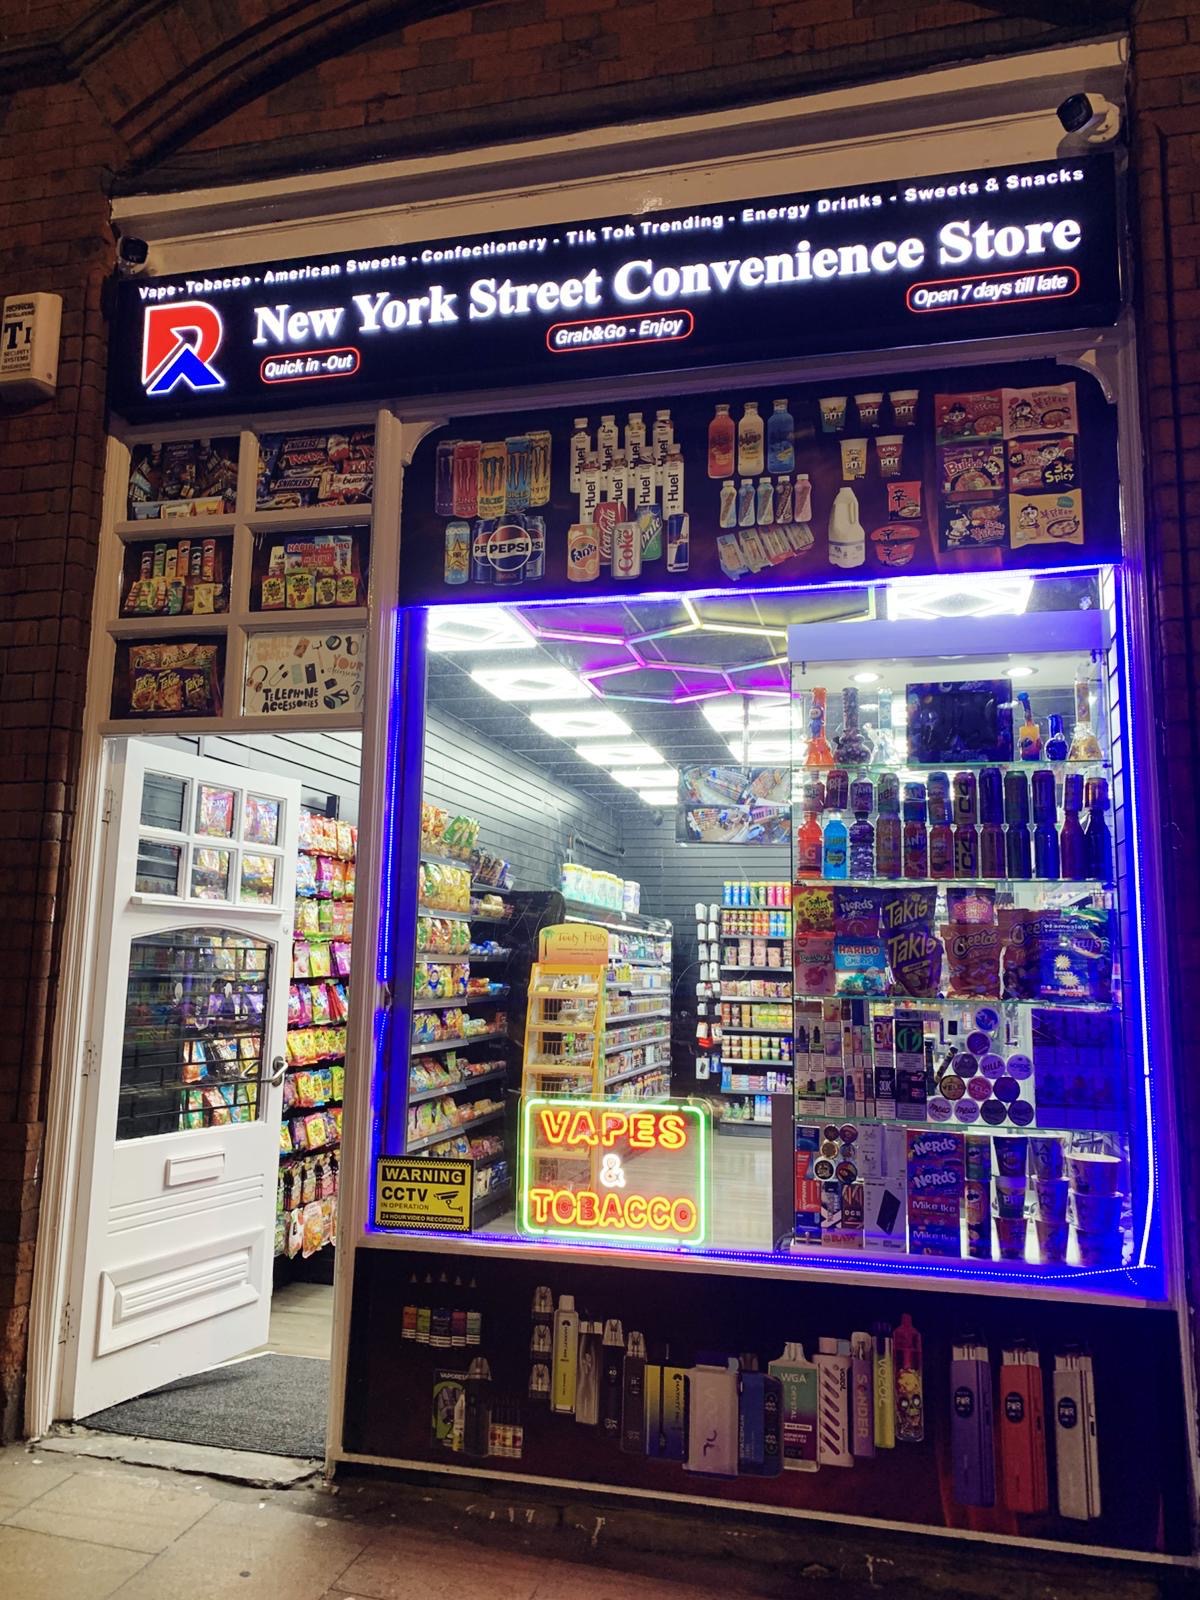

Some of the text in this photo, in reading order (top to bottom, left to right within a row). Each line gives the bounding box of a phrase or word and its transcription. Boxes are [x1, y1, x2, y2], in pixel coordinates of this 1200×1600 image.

[139, 284, 176, 300] Vape
[186, 275, 250, 294] Tobacco
[264, 263, 340, 284] American
[346, 254, 406, 274] Sweets
[421, 236, 547, 264] Confectionery
[566, 229, 597, 245] Tik
[601, 224, 635, 241] Tok
[641, 214, 724, 235] Trending
[742, 204, 810, 223] Energy
[817, 193, 882, 213] Drinks
[904, 181, 979, 202] Sweets
[984, 177, 999, 191] &
[1006, 168, 1084, 190] Snacks
[252, 217, 1082, 345] New York Street Convenience Store
[914, 273, 1068, 307] Open 7 days till late
[639, 317, 684, 337] Enjoy
[264, 358, 304, 378] Quick
[305, 357, 319, 373] in
[639, 474, 651, 504] Huel
[667, 472, 679, 502] Huel
[1044, 471, 1075, 484] Spicy
[584, 480, 596, 509] Huel
[489, 542, 529, 554] PEPSI
[618, 528, 634, 573] Coke
[885, 898, 928, 929] Takis
[837, 944, 880, 955] HARIBO
[888, 931, 937, 969] Takis
[952, 930, 998, 956] Cheetos
[540, 1109, 687, 1150] VAPES
[385, 1167, 463, 1184] WARNING
[599, 1153, 627, 1189] &
[381, 1186, 428, 1202] CCTV
[389, 1202, 429, 1211] OPERATION
[912, 1200, 938, 1210] Mike
[407, 1214, 426, 1222] VIDEO
[426, 1215, 463, 1224] RECORDING
[529, 1187, 697, 1233] TOBACCO
[780, 1372, 807, 1383] WGA
